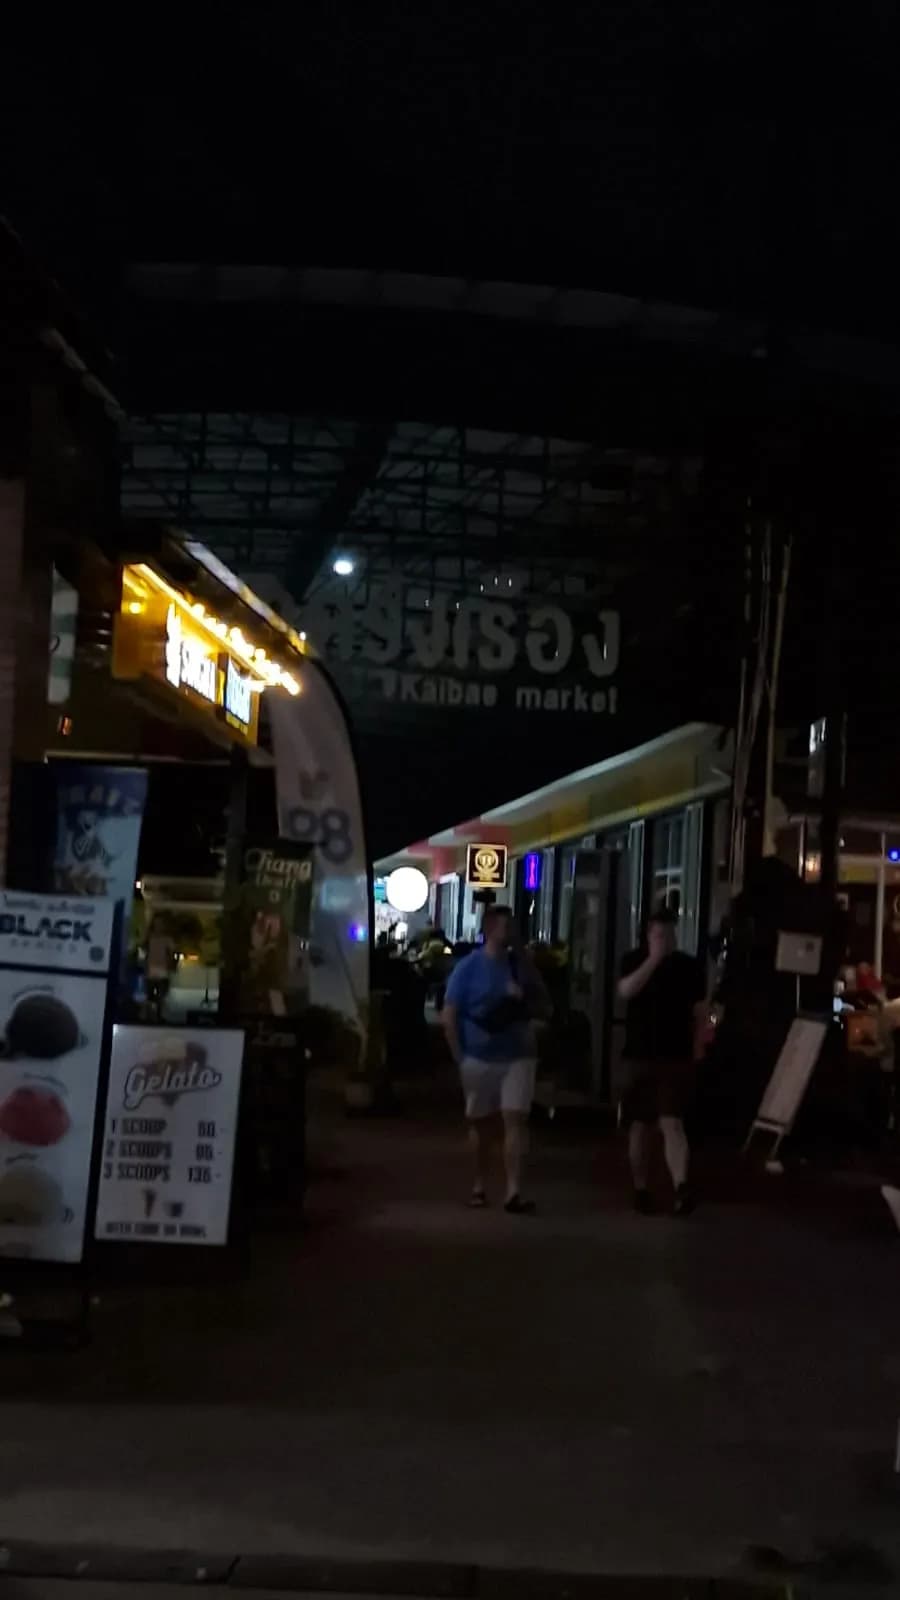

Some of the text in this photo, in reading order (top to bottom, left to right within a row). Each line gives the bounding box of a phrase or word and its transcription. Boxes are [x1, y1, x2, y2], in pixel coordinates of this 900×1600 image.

[400, 677, 619, 715] Kaibae market
[0, 913, 91, 942] BLACK
[125, 1061, 221, 1110] Gelato
[111, 1118, 117, 1135] 1
[121, 1118, 168, 1136] SCOOP
[106, 1139, 115, 1158] 2
[119, 1140, 173, 1160] SCOOPS
[103, 1161, 113, 1180] 3
[117, 1162, 171, 1182] SCOOPS
